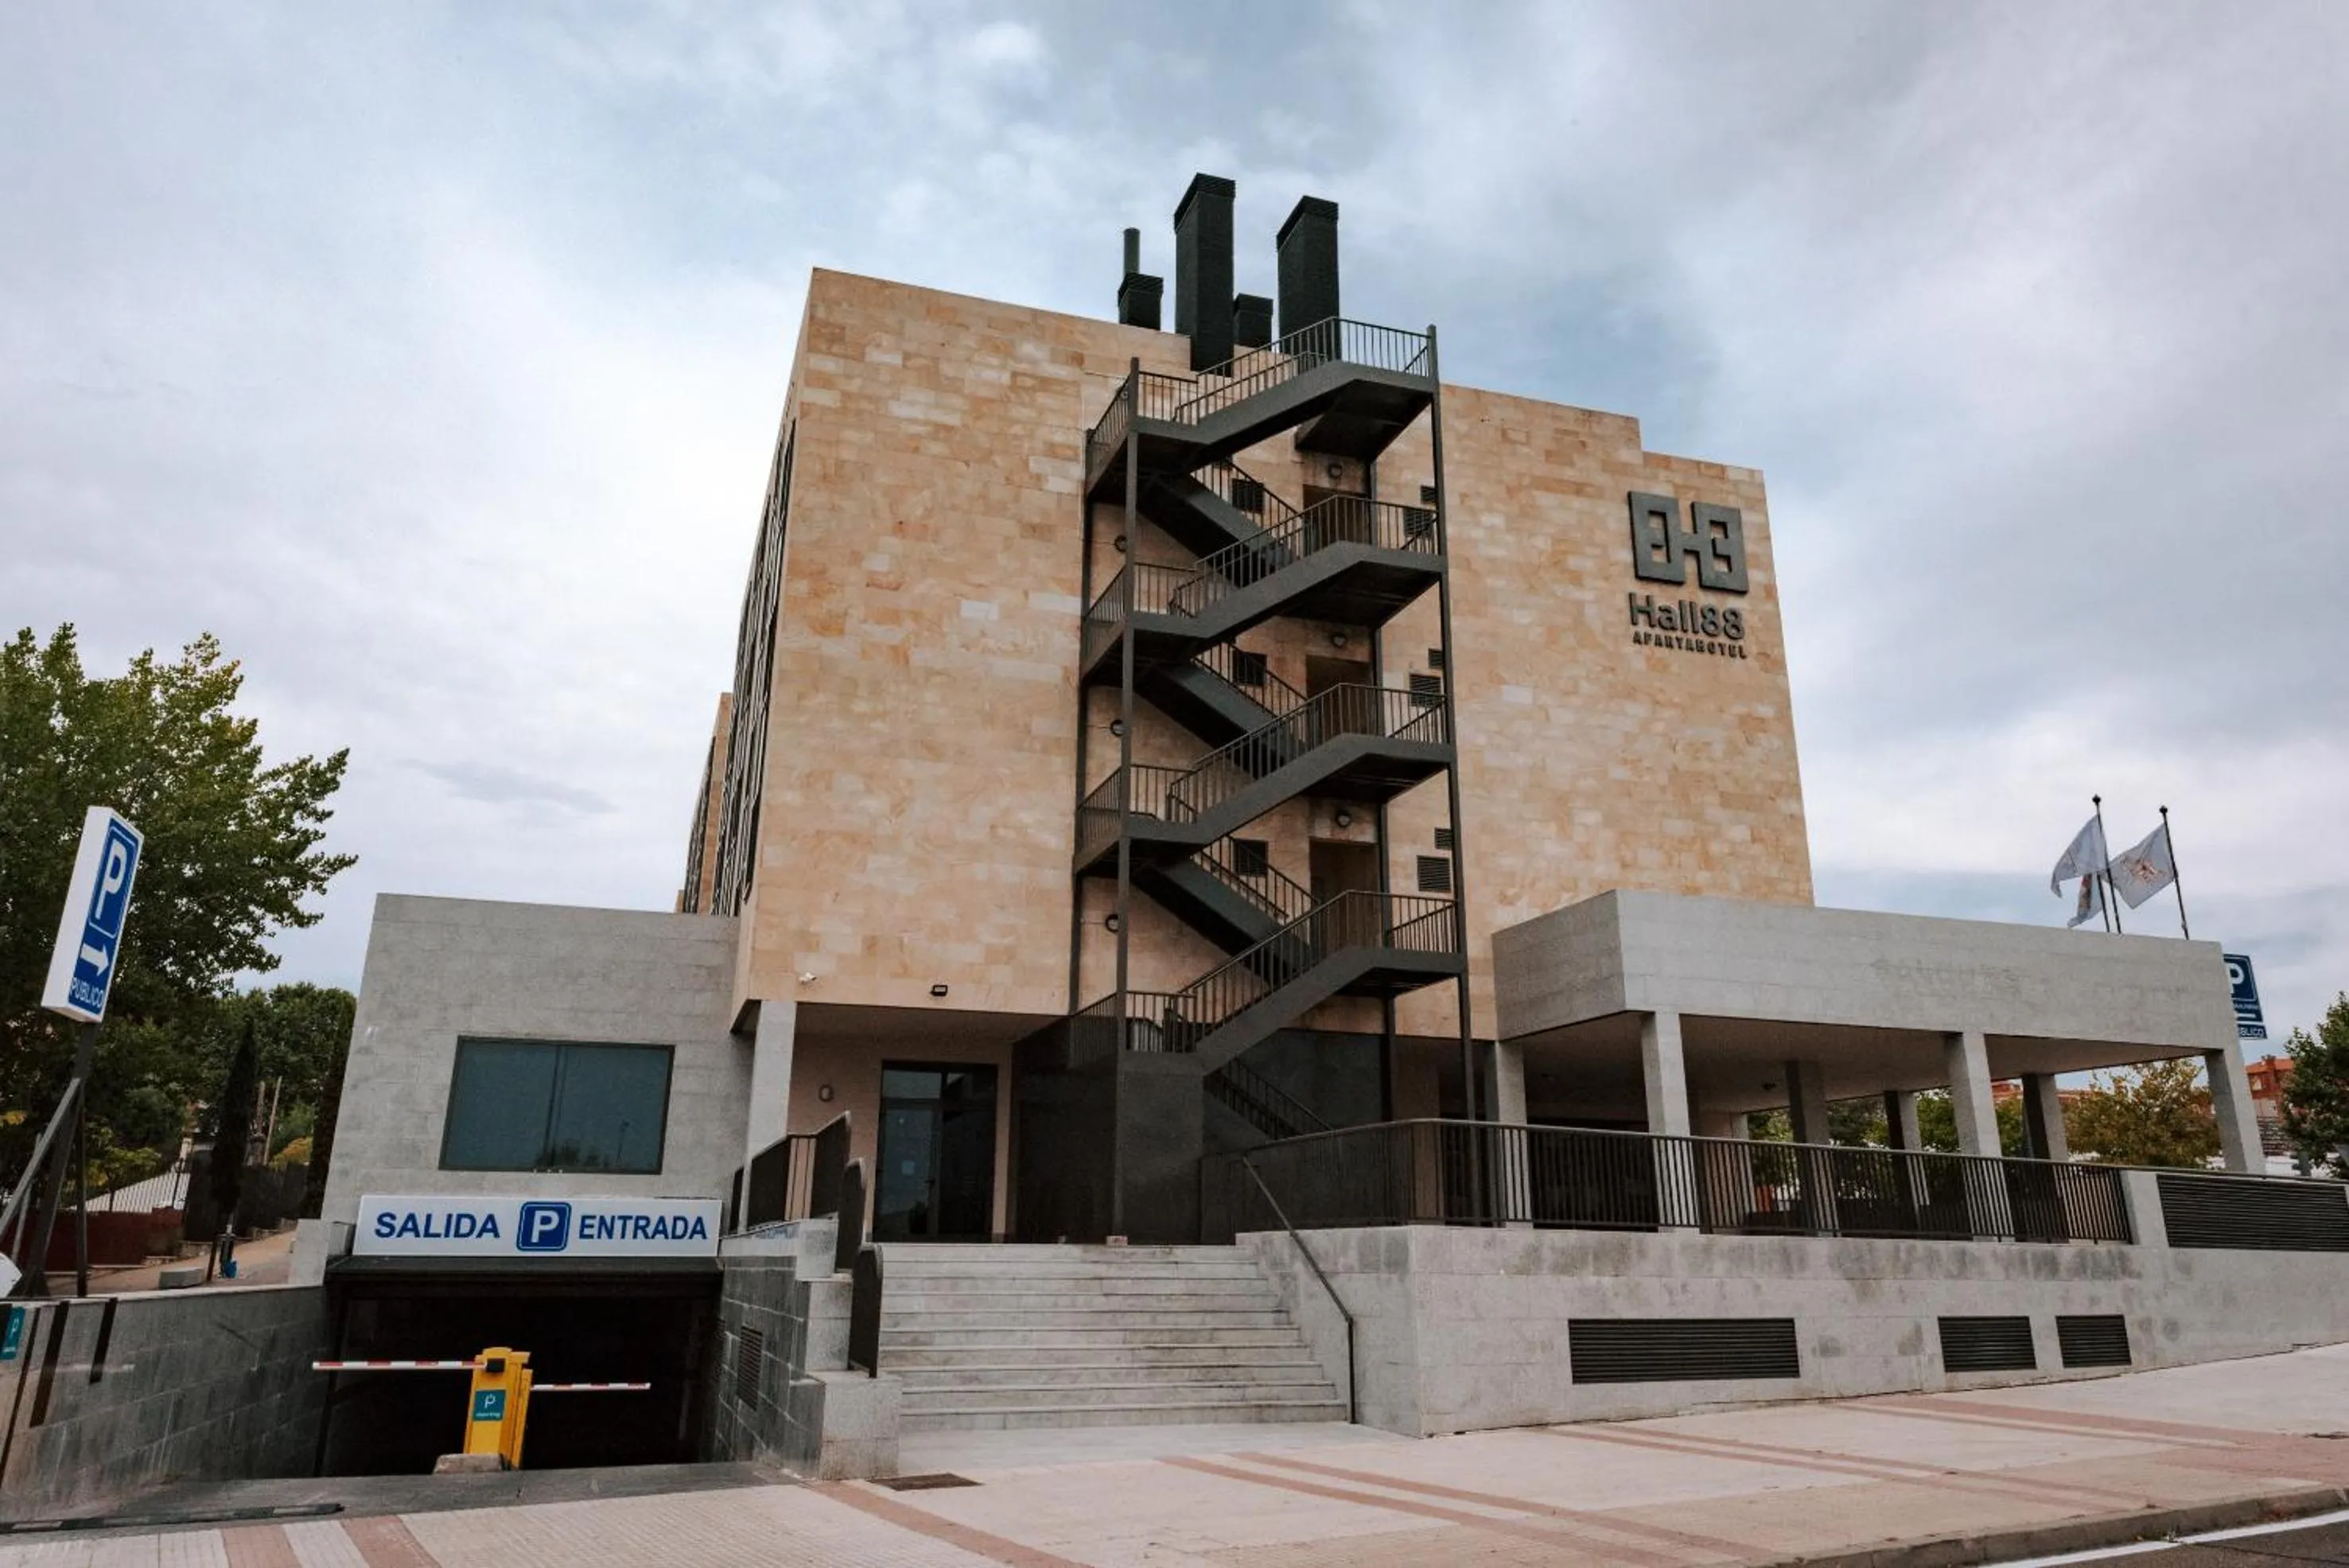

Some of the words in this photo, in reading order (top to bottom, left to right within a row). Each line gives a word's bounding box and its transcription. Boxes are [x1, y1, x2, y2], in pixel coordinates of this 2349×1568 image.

[1628, 592, 1745, 640] Hall88
[95, 838, 127, 920] P
[2227, 963, 2244, 994] P
[2240, 1027, 2264, 1036] BLICO
[375, 1212, 500, 1239] SALIDA
[531, 1209, 560, 1243] P
[578, 1215, 707, 1240] ENTRADA
